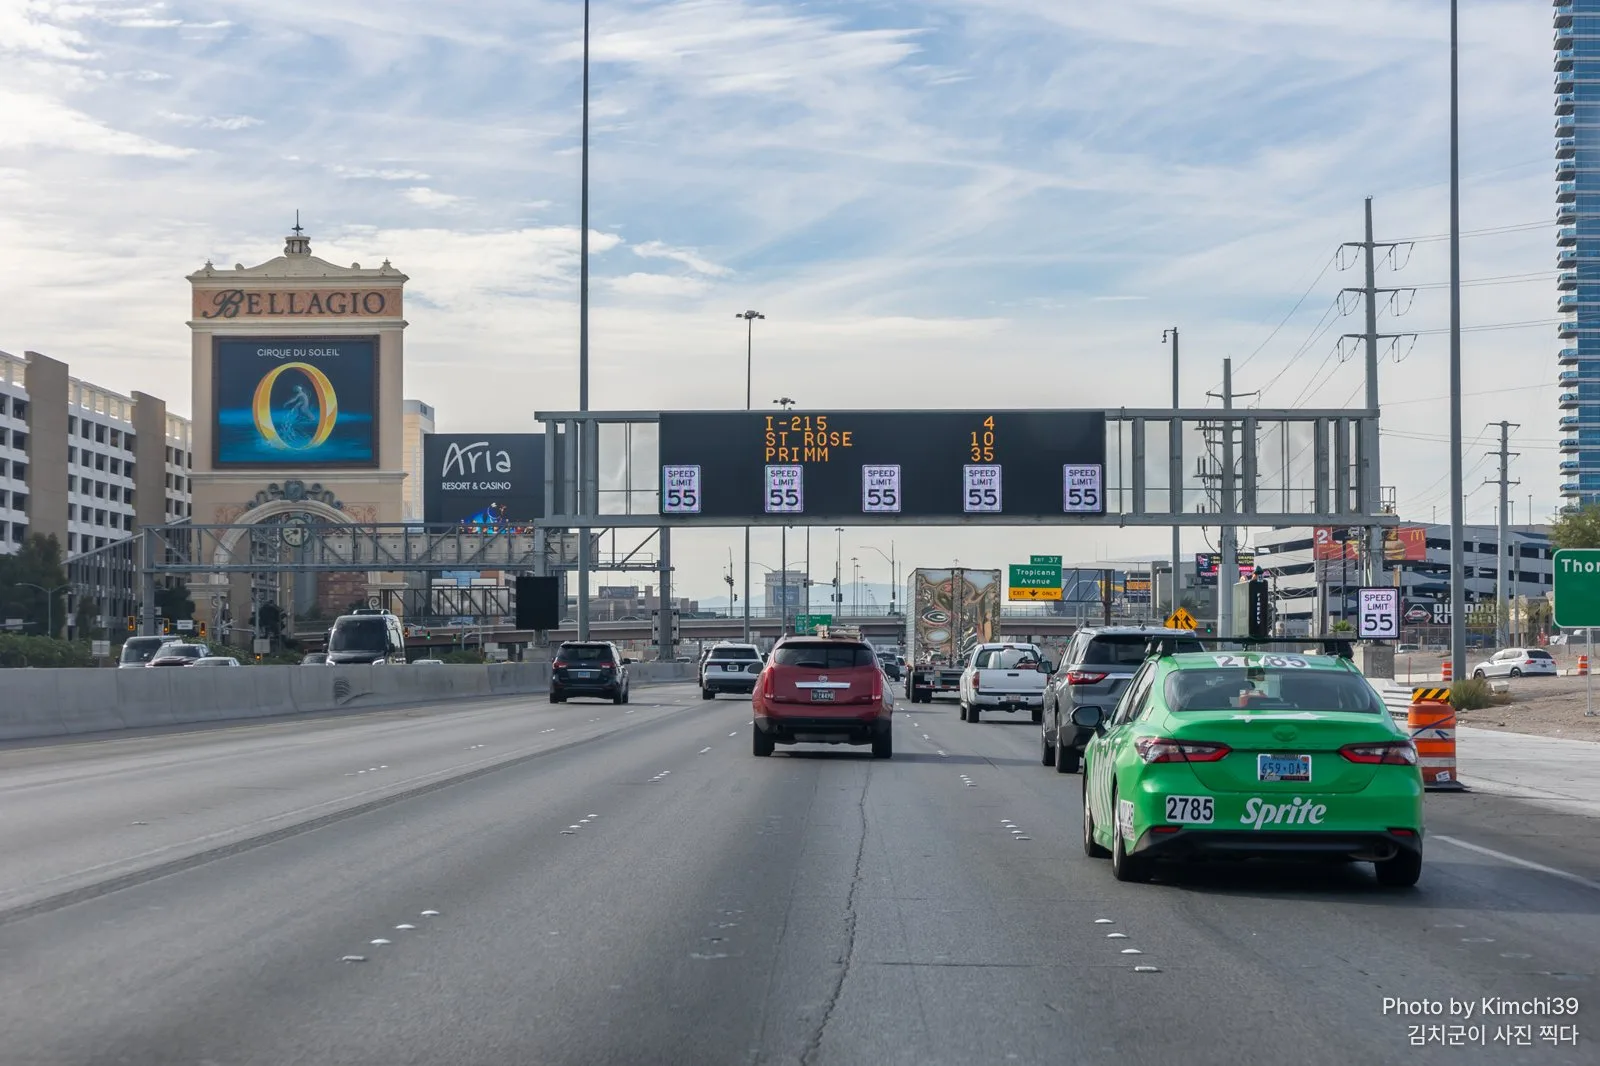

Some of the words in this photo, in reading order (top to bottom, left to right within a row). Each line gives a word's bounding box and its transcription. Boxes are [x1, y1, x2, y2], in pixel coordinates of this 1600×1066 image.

[203, 289, 385, 318] BELLAGIO
[257, 349, 291, 358] CIRQUE
[293, 349, 307, 357] DU
[308, 349, 340, 357] SOLEIL
[765, 416, 828, 431] I-215
[983, 415, 995, 431] 4
[765, 432, 789, 447] ST
[804, 432, 853, 447] ROSE
[970, 431, 994, 446] 10
[765, 447, 829, 462] PRIMM
[970, 447, 994, 462] 35
[442, 441, 511, 477] Aria
[668, 470, 695, 478] SPEED
[770, 470, 798, 478] SPEED
[867, 470, 895, 478] SPEED
[969, 470, 996, 478] SPEED
[1068, 469, 1096, 477] SPEED
[442, 482, 471, 490] RESORT
[472, 482, 478, 490] &
[480, 482, 511, 490] CASINO
[671, 479, 692, 487] LIMIT
[773, 479, 795, 487] LIMIT
[871, 479, 892, 487] LIMIT
[972, 479, 993, 487] LIMIT
[1072, 478, 1093, 486] LIMIT
[667, 489, 697, 507] 55
[770, 489, 799, 507] 55
[867, 489, 896, 507] 55
[968, 489, 997, 507] 55
[1068, 488, 1098, 506] 55
[1016, 569, 1056, 577] Tropicana
[1364, 594, 1392, 602] SPEED
[1367, 603, 1389, 611] LIMIT
[1364, 614, 1393, 632] 55
[1167, 797, 1213, 821] 2785
[1240, 797, 1327, 830] Sprite
